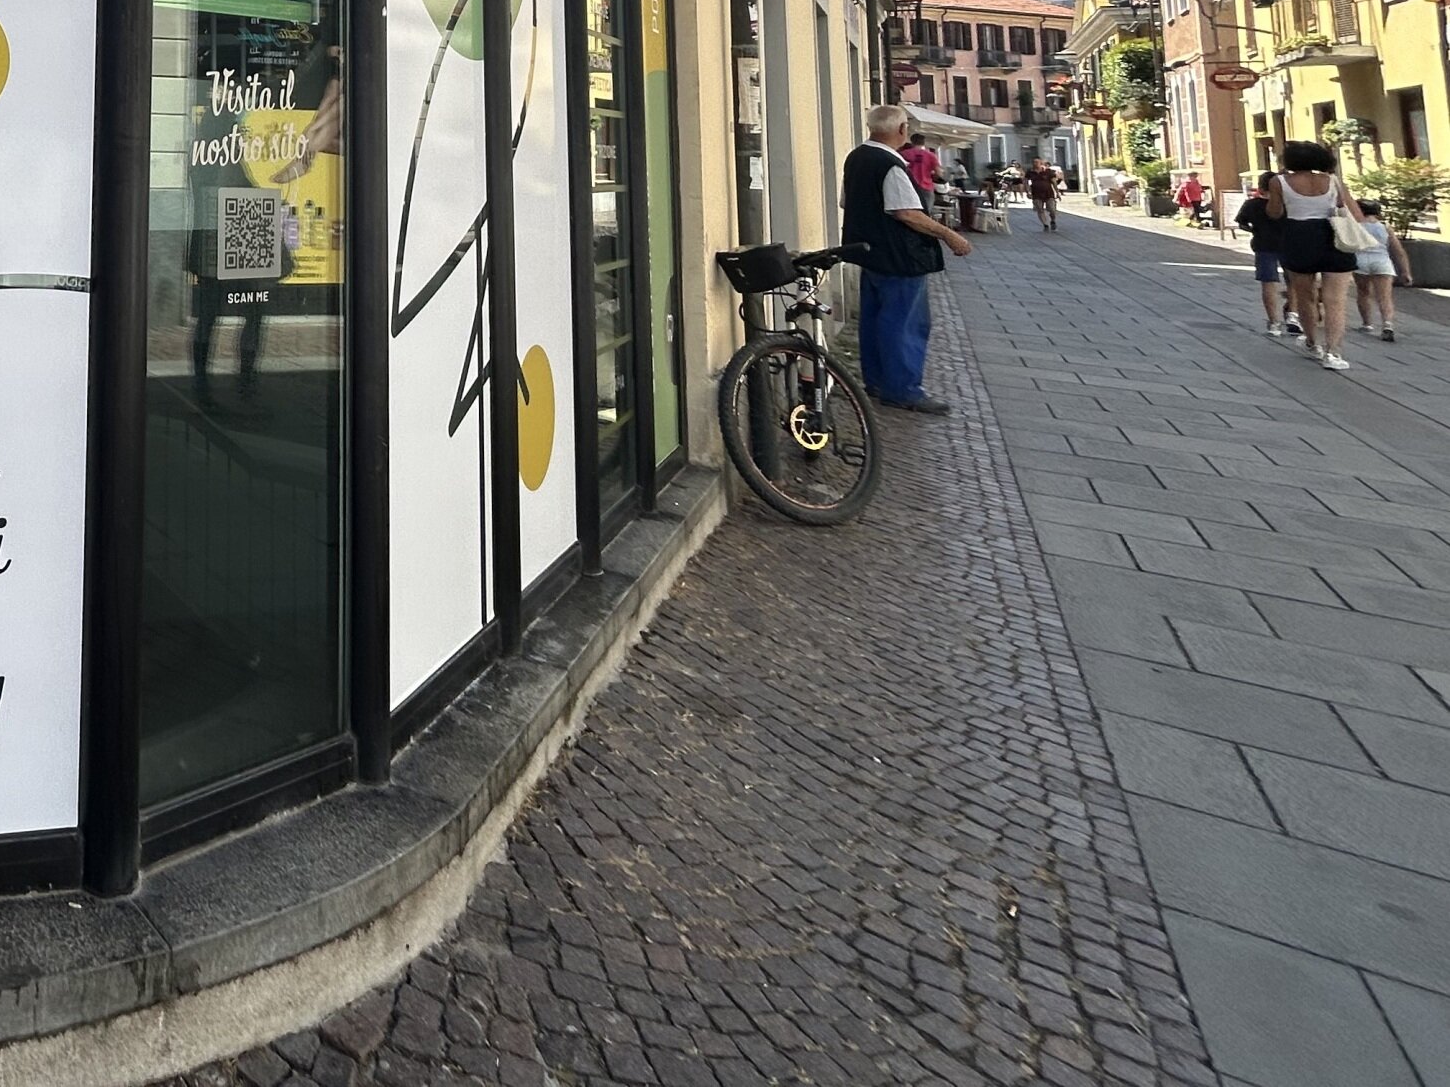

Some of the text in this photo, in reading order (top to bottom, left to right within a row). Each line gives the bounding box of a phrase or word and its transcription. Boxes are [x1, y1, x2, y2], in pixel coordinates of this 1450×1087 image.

[206, 68, 296, 116] Visita il
[192, 122, 309, 166] nostro sito
[227, 291, 269, 304] SCAN ME
